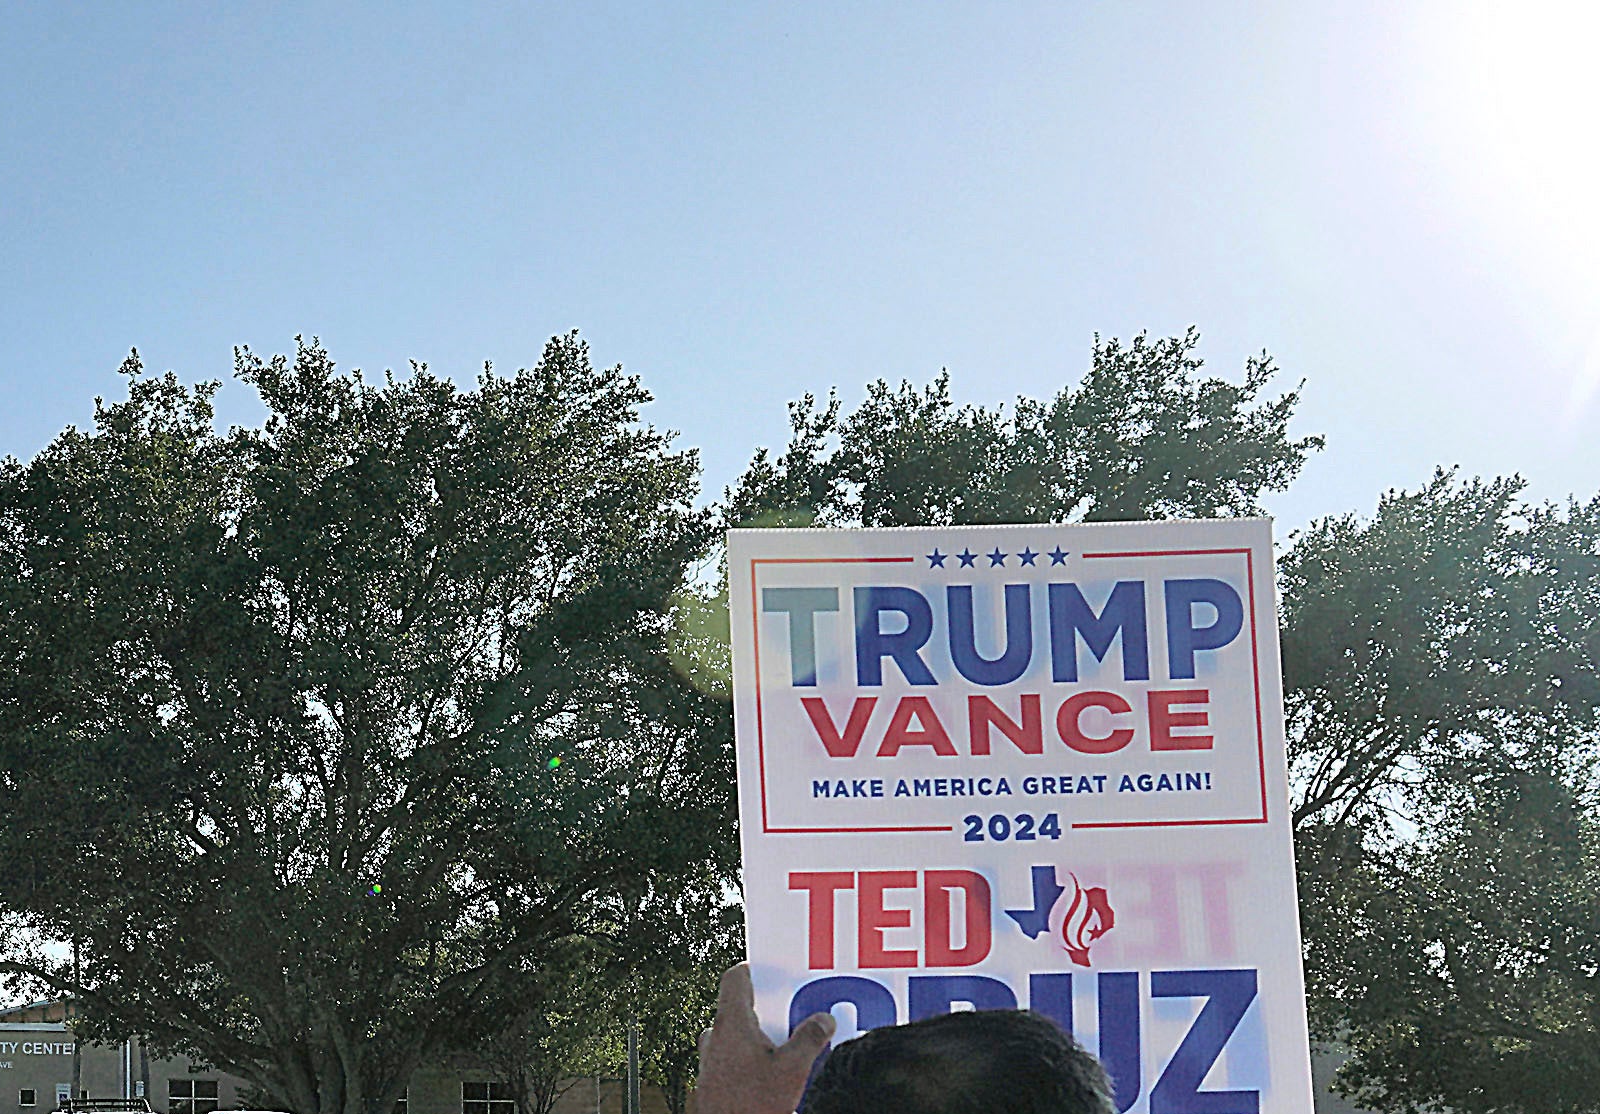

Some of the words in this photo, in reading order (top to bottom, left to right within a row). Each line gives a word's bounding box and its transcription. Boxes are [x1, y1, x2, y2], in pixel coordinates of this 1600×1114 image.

[762, 579, 1244, 688] TRUMP
[800, 689, 1215, 759] VANCE
[812, 777, 884, 799] MAKE
[894, 776, 1013, 798] AMERICA
[1022, 774, 1108, 796] GREAT
[1118, 771, 1212, 794] AGAIN!
[962, 812, 1063, 842] 2024
[788, 869, 993, 969] TED
